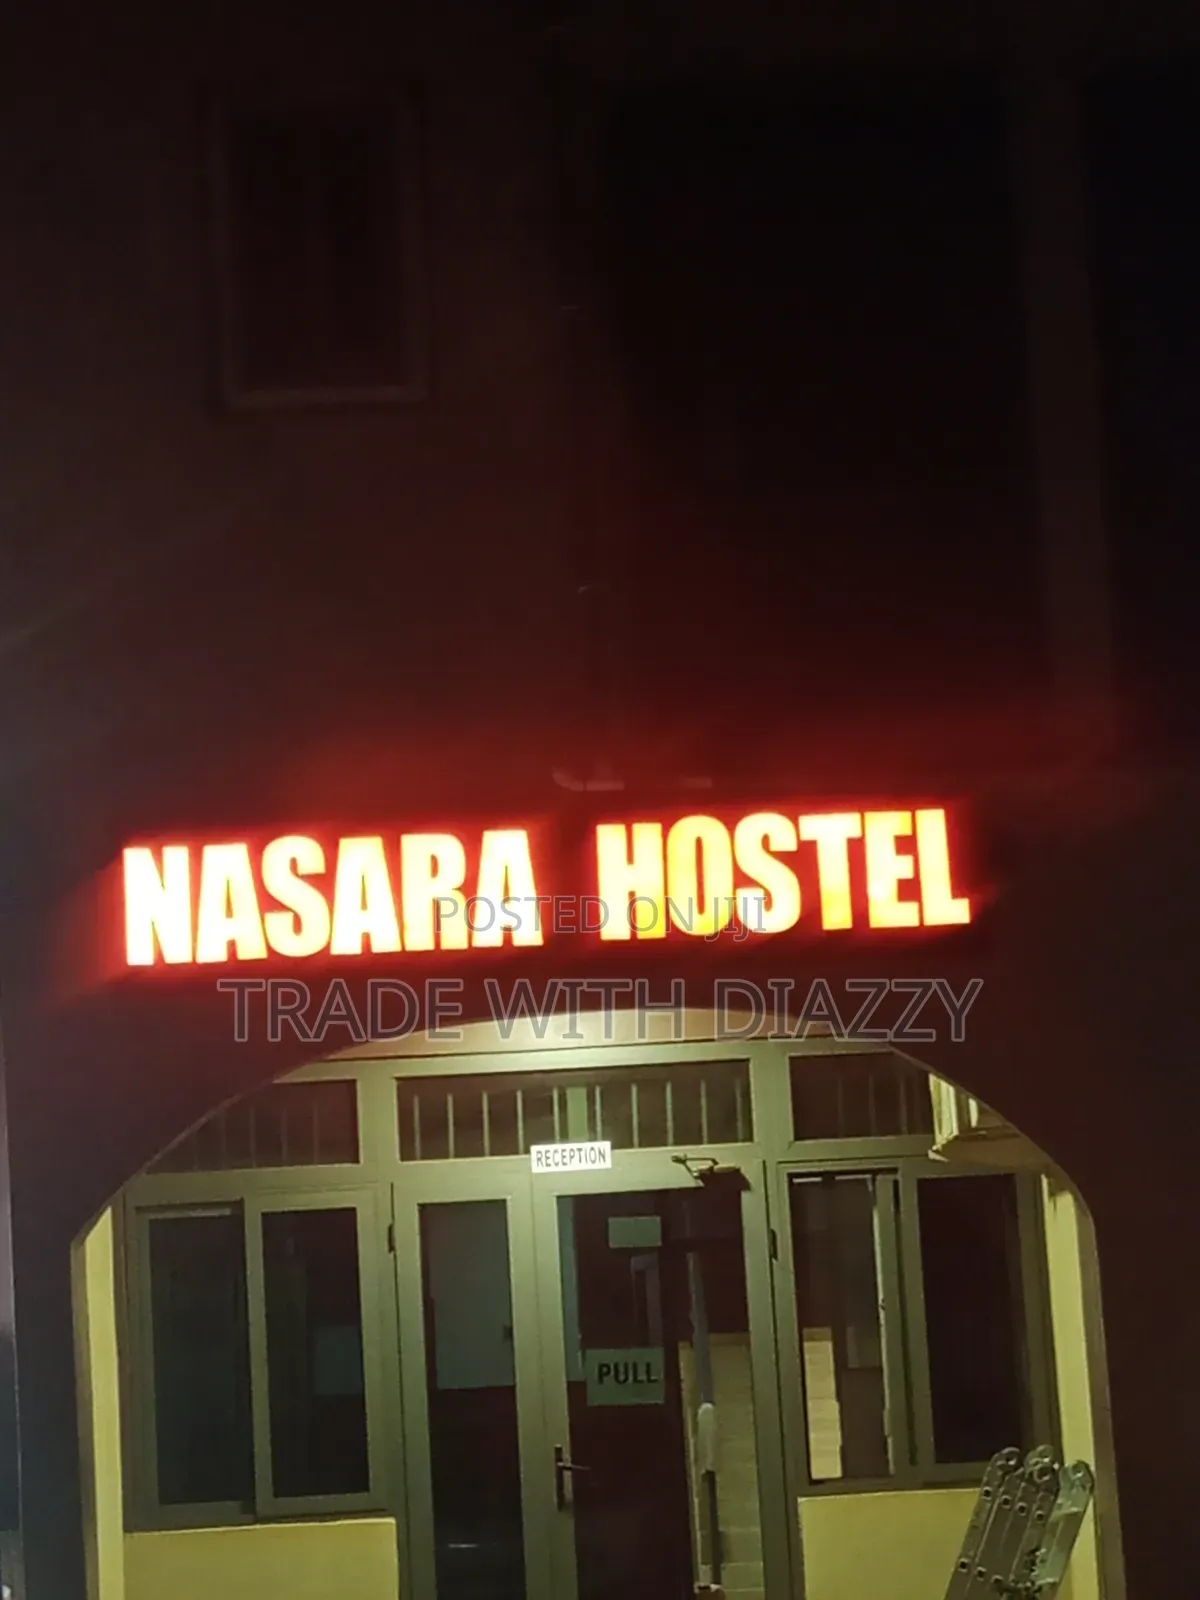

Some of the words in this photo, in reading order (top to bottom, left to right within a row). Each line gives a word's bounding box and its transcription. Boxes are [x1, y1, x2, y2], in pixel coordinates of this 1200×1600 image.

[123, 829, 544, 966] NASARA
[596, 808, 971, 941] HOSTEL
[535, 1146, 607, 1169] RECEPTION
[598, 1361, 660, 1385] PULL
